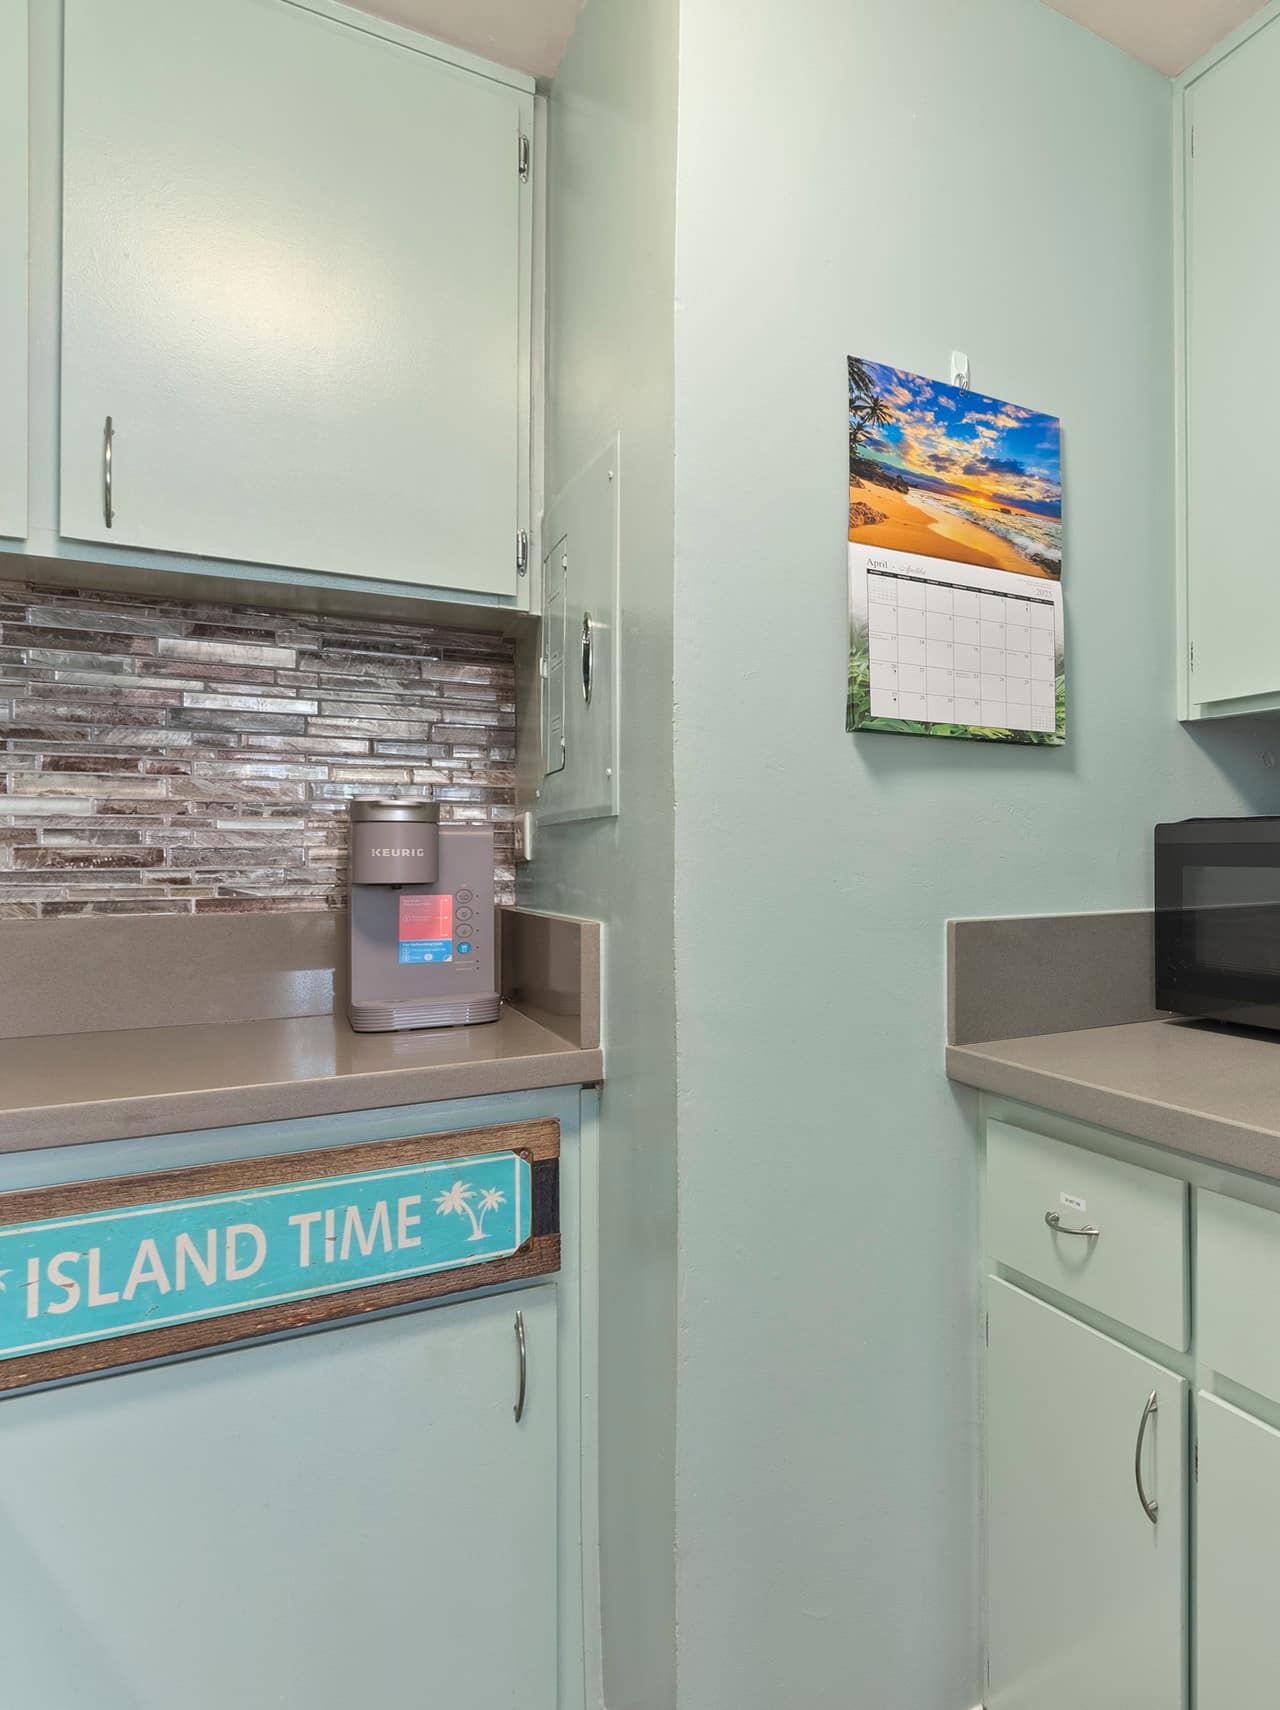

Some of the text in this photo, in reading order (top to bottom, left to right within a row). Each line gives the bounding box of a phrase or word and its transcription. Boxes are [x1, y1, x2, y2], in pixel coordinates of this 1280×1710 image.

[866, 557, 888, 569] April
[372, 848, 424, 857] KEURIG
[26, 1195, 423, 1320] ISLAND TIME
